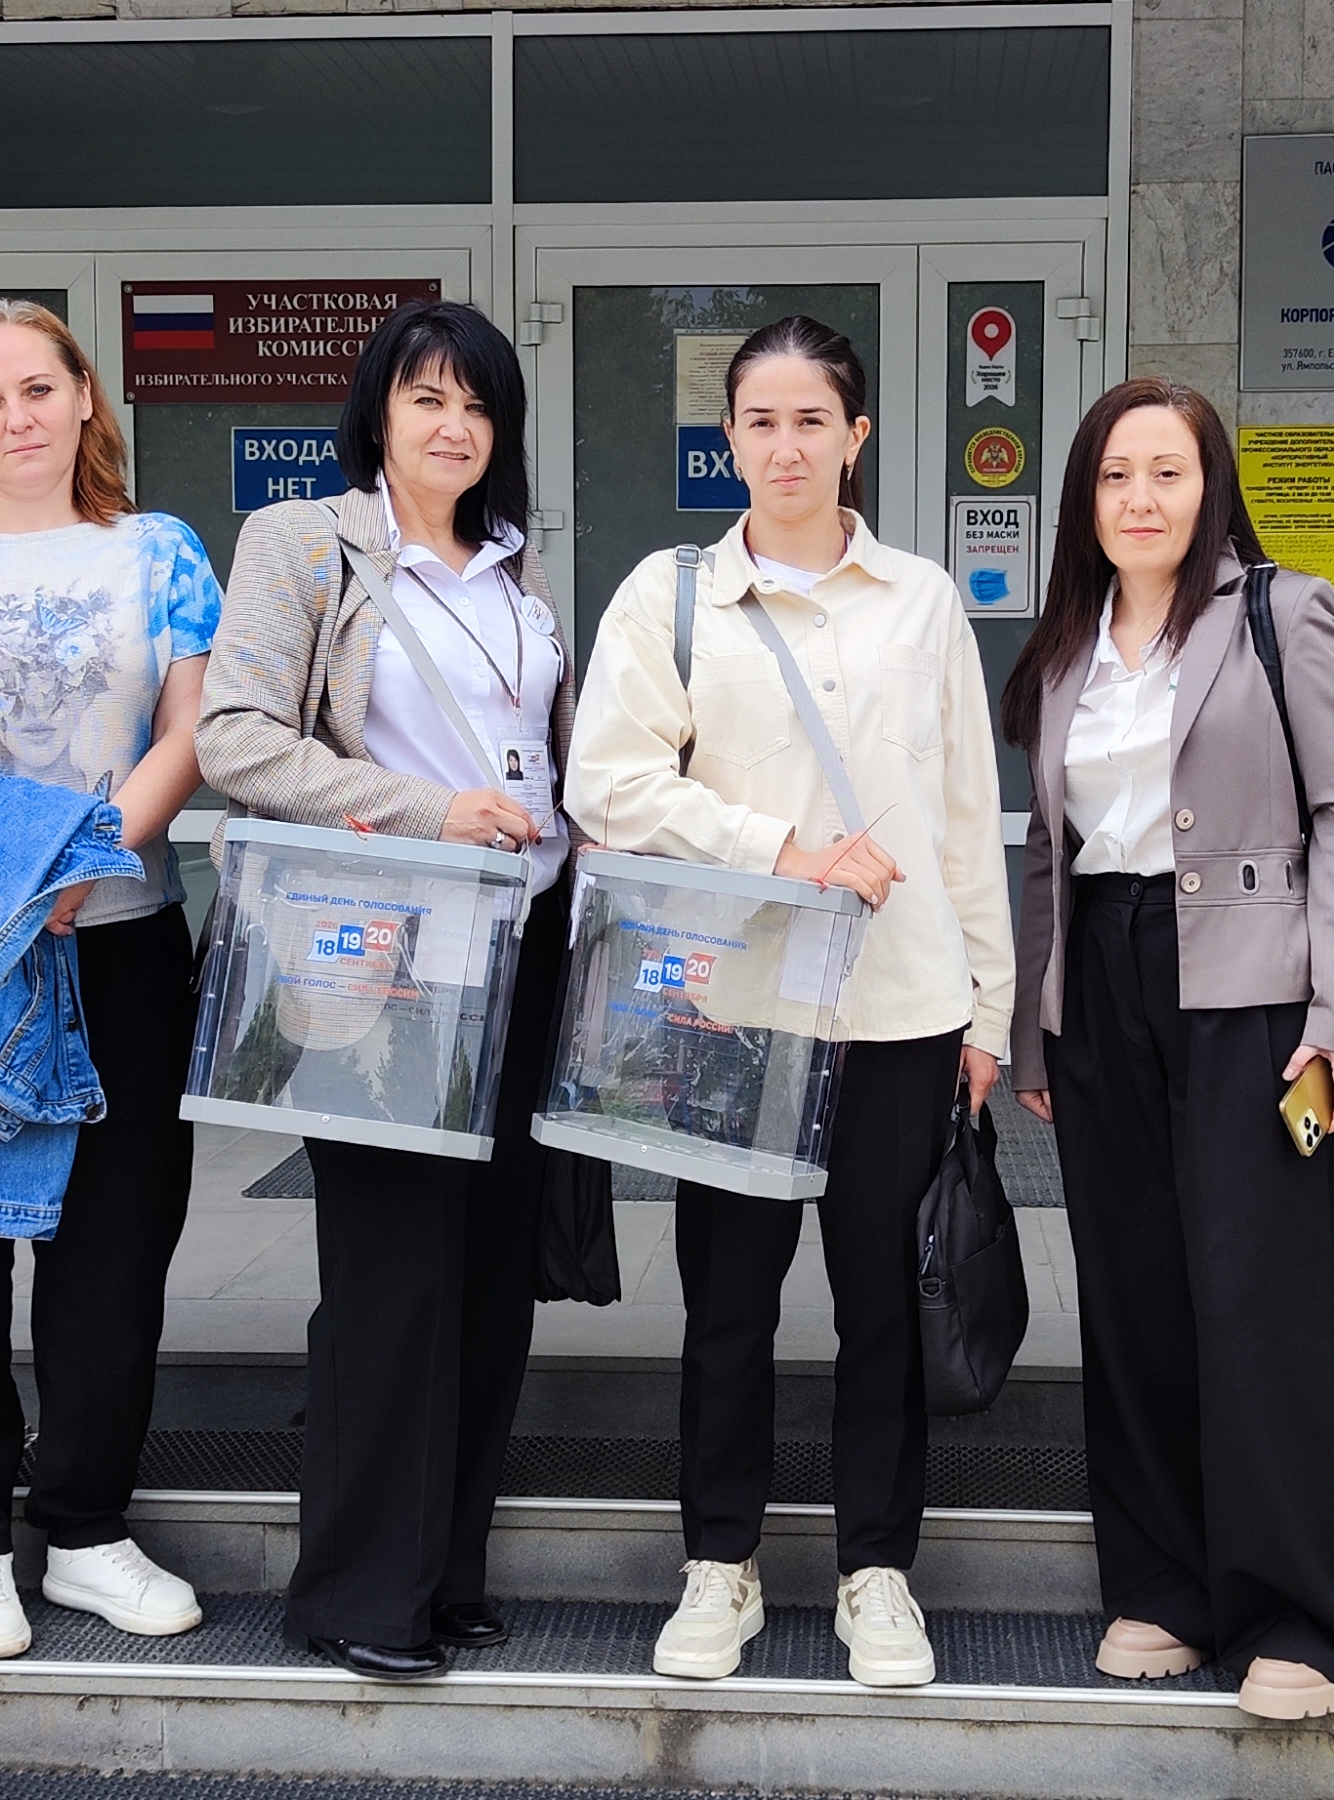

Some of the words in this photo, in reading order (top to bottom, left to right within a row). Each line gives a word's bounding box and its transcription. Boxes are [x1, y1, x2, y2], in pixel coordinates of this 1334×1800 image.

[247, 293, 398, 311] УЧАСТКОВАЯ
[228, 316, 385, 334] ИЗБИРАТЕЛЬН
[257, 340, 367, 357] КОМИСС
[1283, 348, 1317, 359] 357600,
[1281, 363, 1294, 373] ул.
[135, 373, 272, 386] ИЗБИРАТЕЛЬНОГО
[276, 372, 348, 386] УЧАСТКА
[244, 439, 339, 466] ВХОДА
[267, 477, 317, 499] НЕТ
[966, 509, 1019, 528] ВХОД
[965, 530, 984, 539] БЕЗ
[986, 530, 1019, 539] МАСКИ
[966, 545, 1019, 555] ЗАПРЕЩЕН
[286, 891, 328, 904] ЕДИНЫЙ
[330, 896, 356, 907] ДЕНЬ
[358, 899, 432, 916] ГОЛОСОВАНИЯ
[315, 939, 335, 956] 18
[341, 932, 361, 950] 19
[366, 927, 392, 945] 20
[656, 926, 680, 938] ДЕНЬ
[681, 931, 747, 950] ГОЛОСОВАНИЯ
[642, 968, 659, 985] 18
[665, 962, 683, 981] 19
[687, 958, 710, 978] 20
[303, 978, 336, 989] ГОЛОС
[668, 1013, 693, 1026] СИЛА
